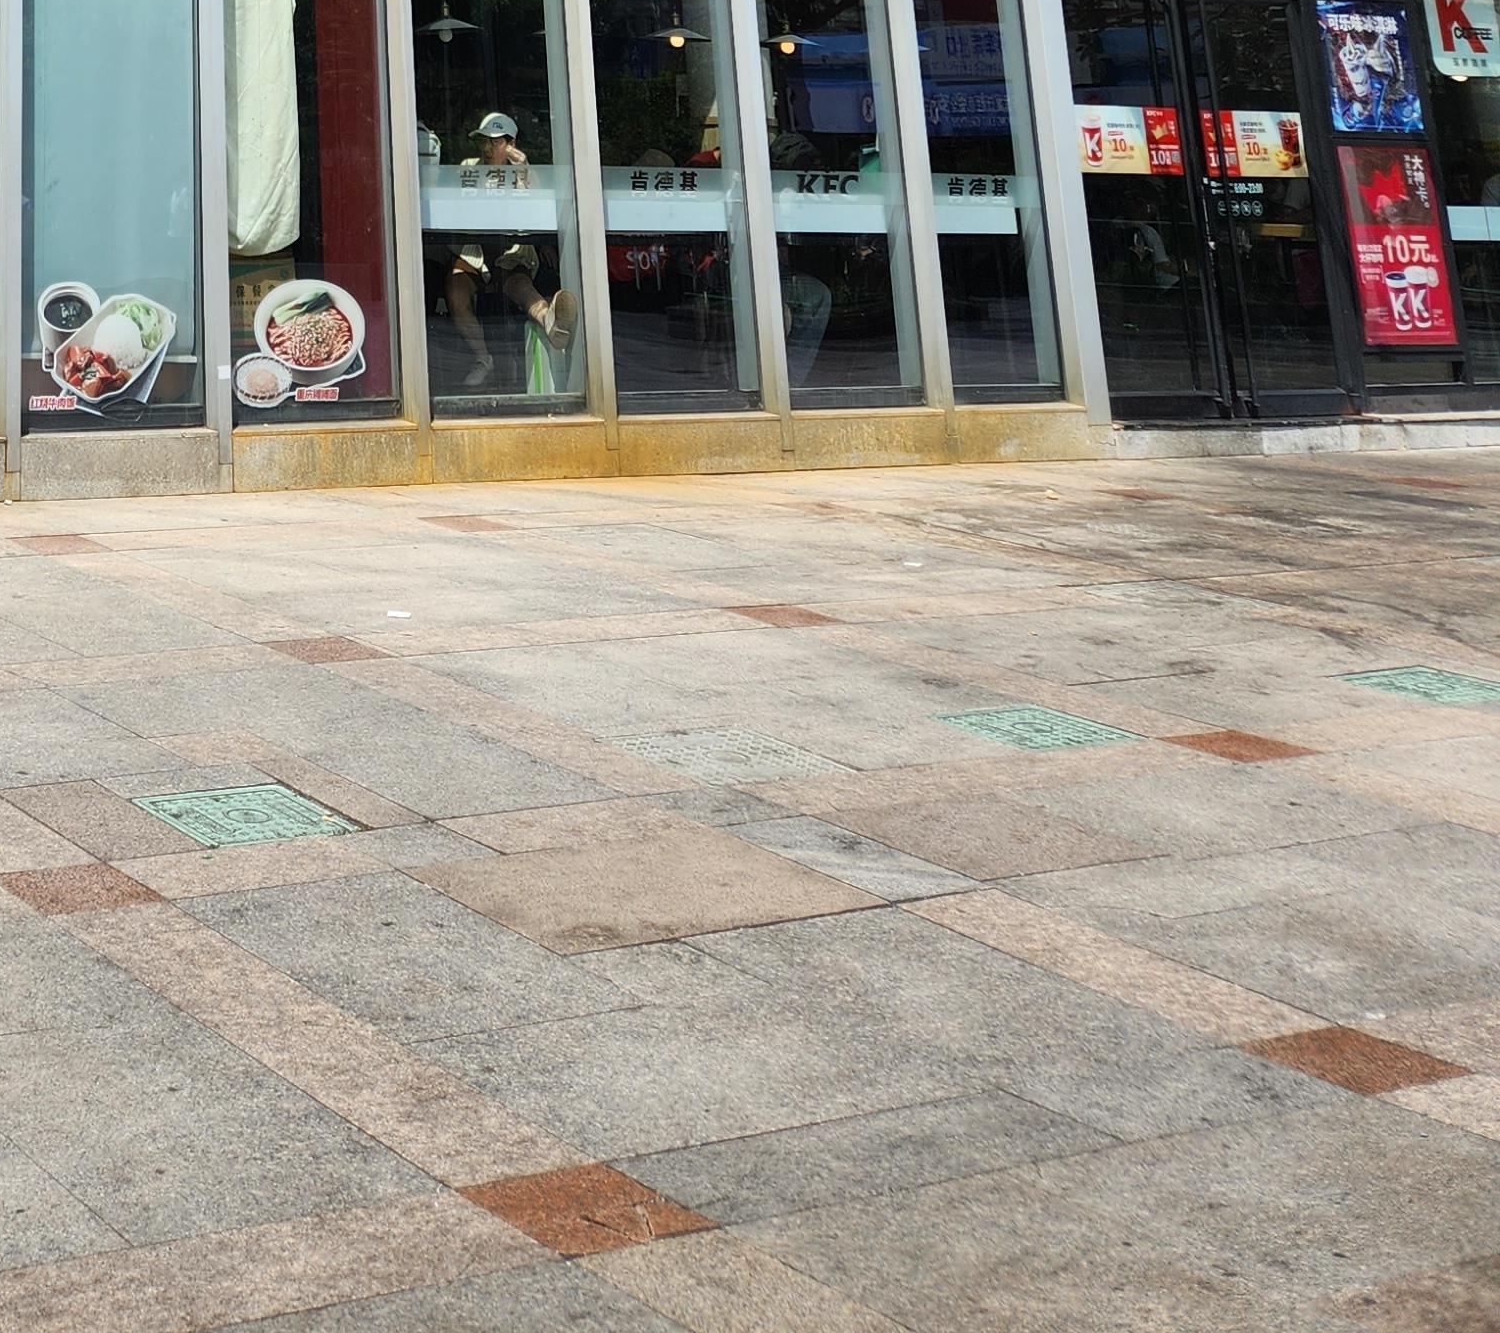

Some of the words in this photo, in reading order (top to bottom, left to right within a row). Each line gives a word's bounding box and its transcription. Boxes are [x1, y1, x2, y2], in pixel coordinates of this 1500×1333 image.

[630, 170, 698, 198] 肯德基
[796, 171, 859, 201] KFC
[947, 175, 1008, 204] 肯德基
